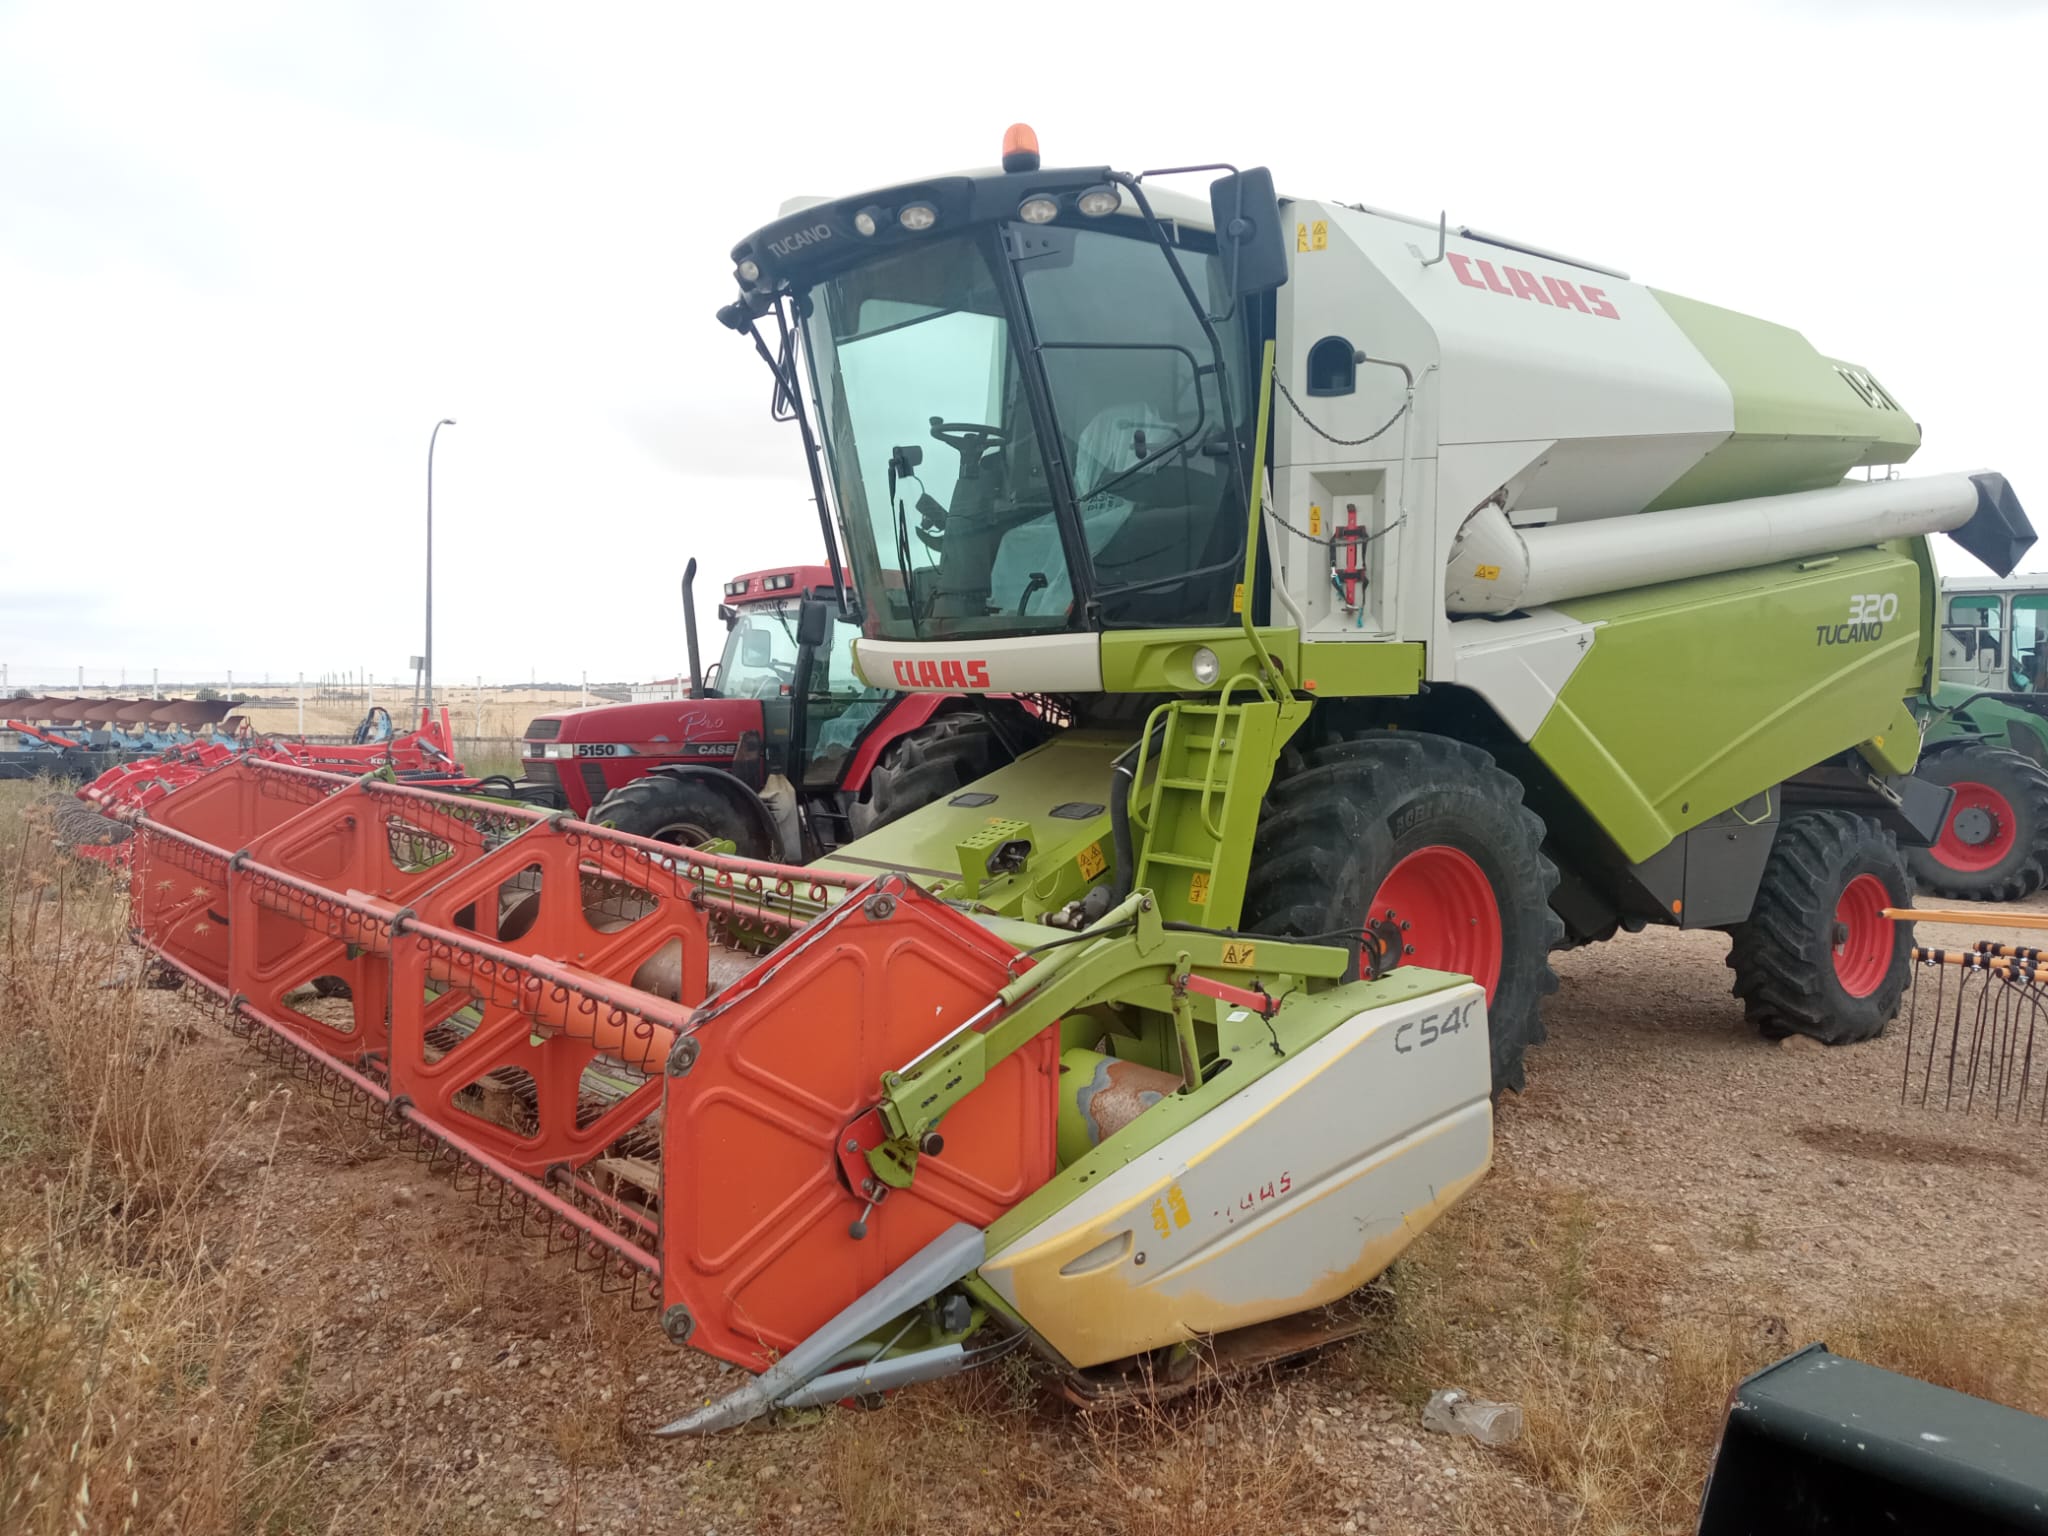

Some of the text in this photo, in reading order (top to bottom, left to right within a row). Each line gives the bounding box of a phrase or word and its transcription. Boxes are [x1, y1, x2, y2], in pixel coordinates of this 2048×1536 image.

[768, 224, 832, 257] TUCANO
[1446, 252, 1621, 321] CLAAS
[1847, 593, 1898, 624] 320
[1817, 621, 1883, 646] TUCANO
[893, 660, 990, 688] CLAAS
[578, 744, 615, 756] 5150
[698, 745, 736, 755] CASE
